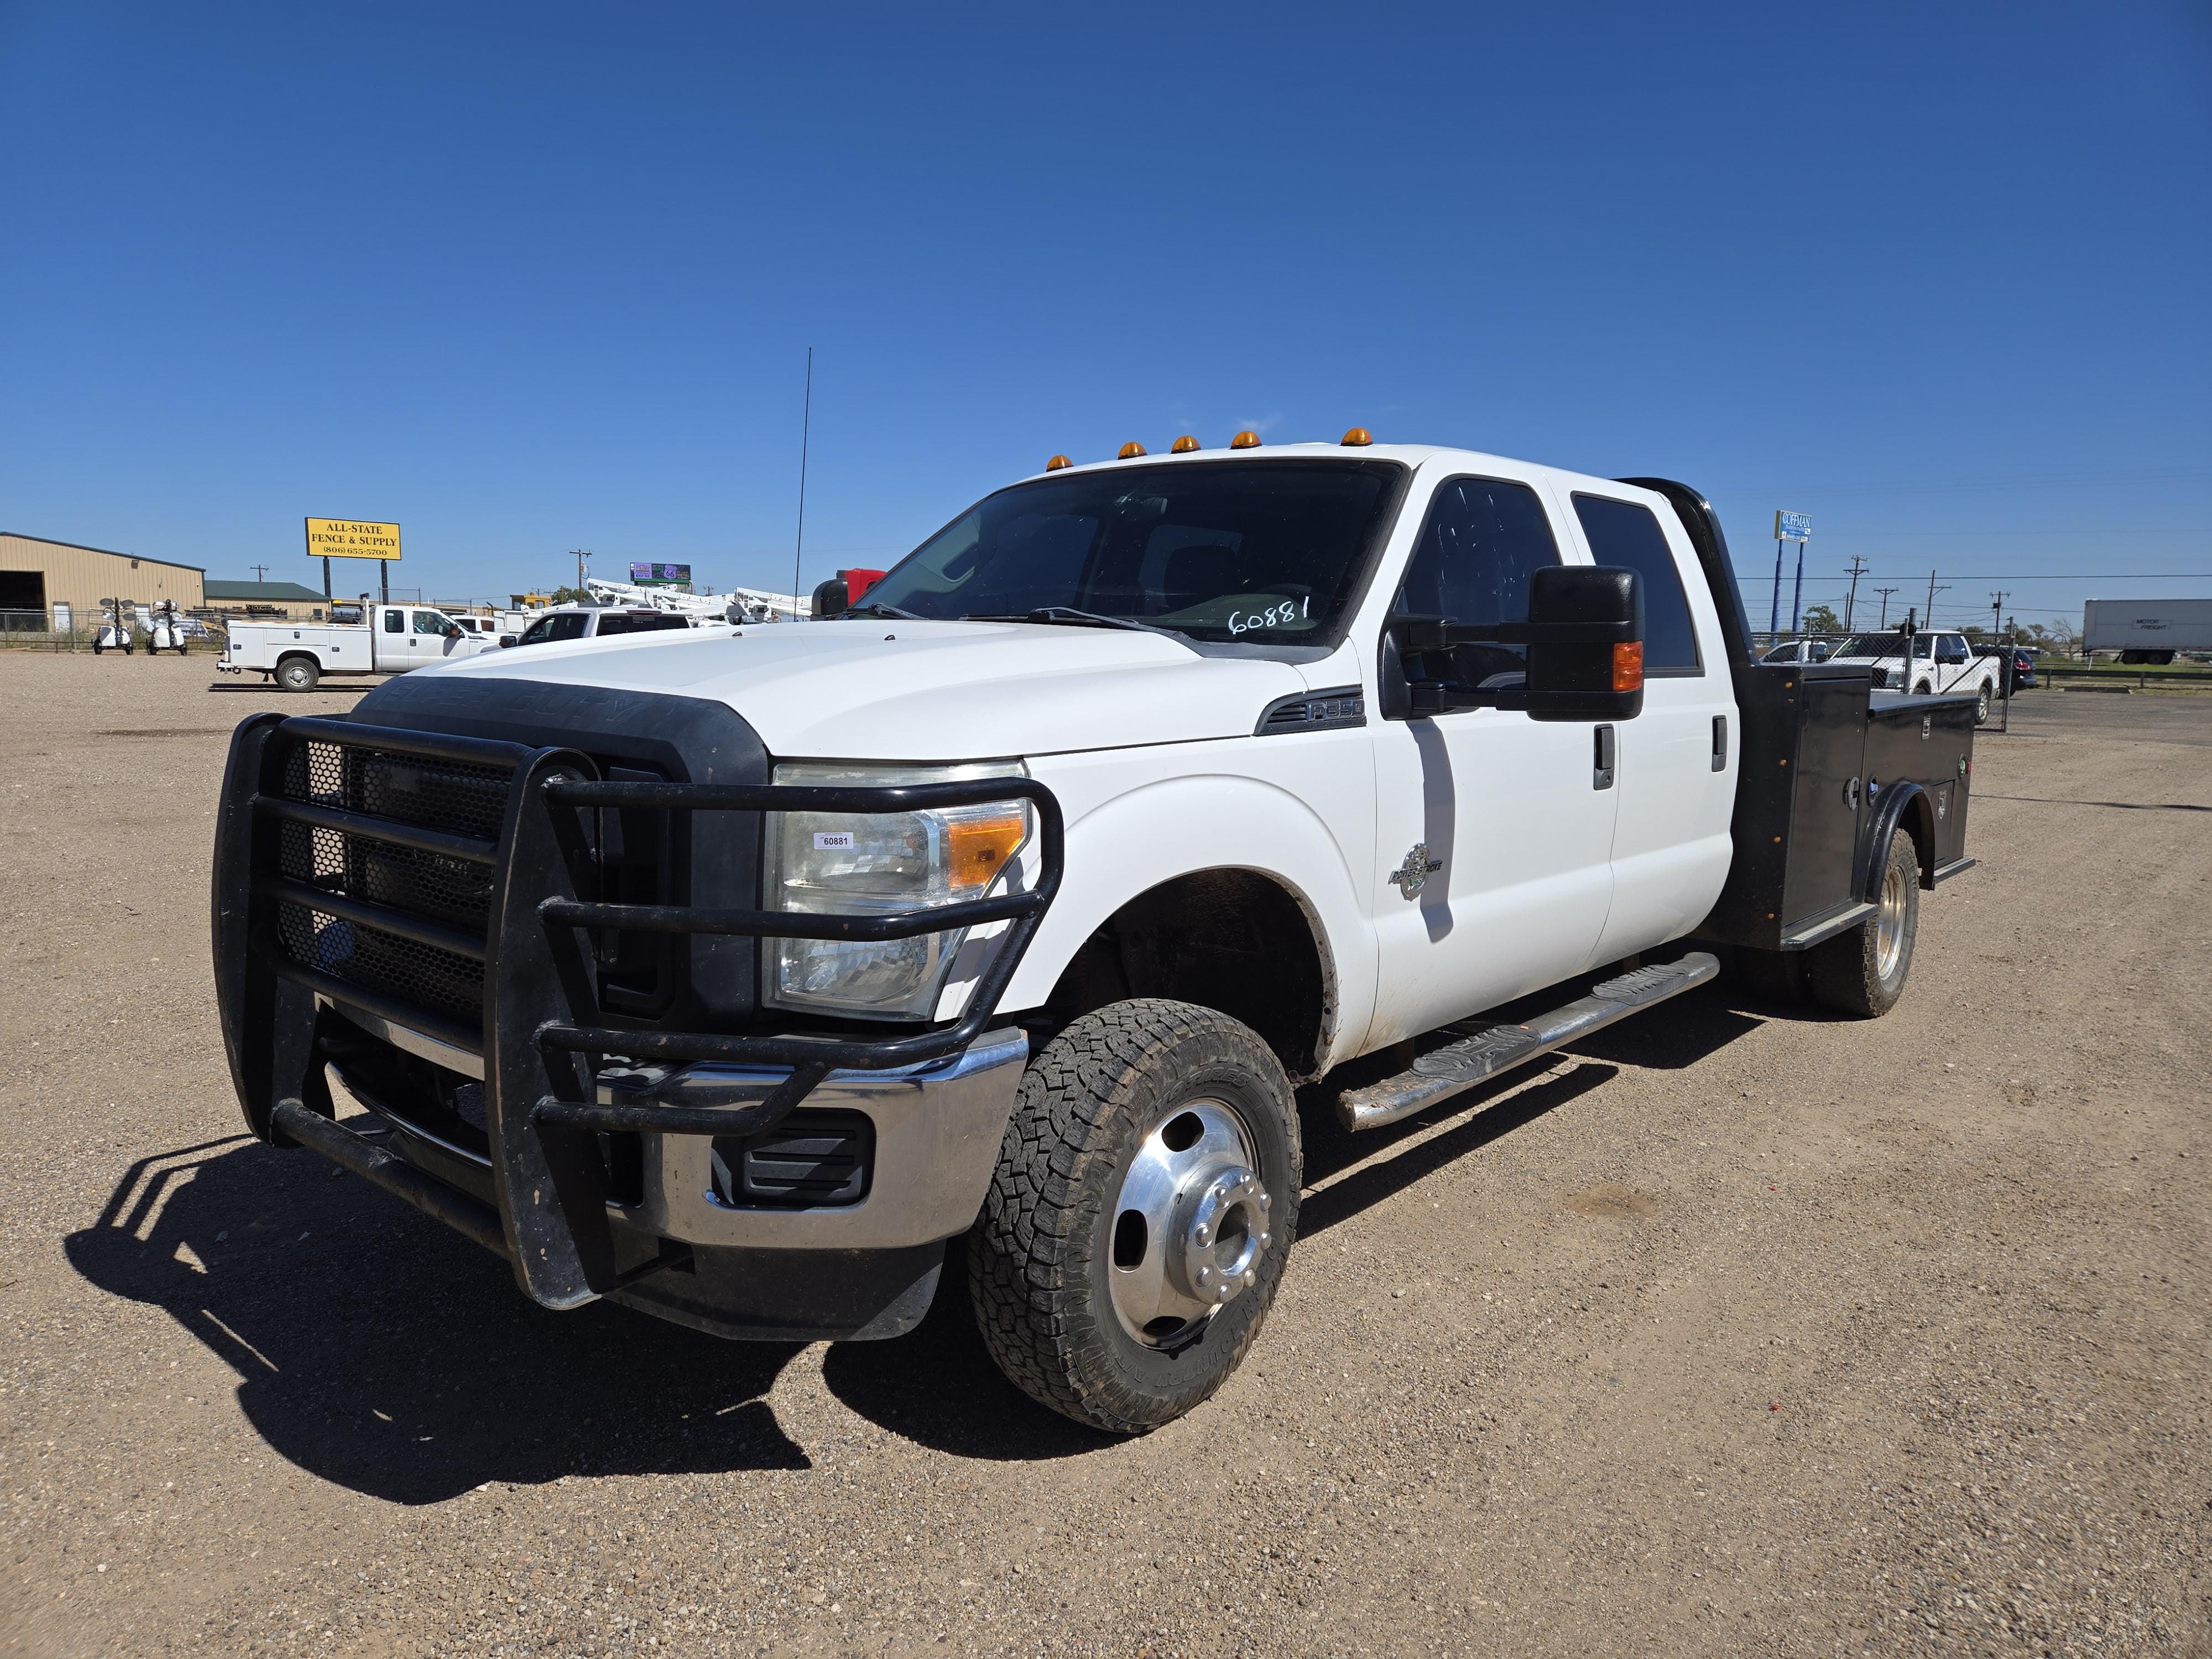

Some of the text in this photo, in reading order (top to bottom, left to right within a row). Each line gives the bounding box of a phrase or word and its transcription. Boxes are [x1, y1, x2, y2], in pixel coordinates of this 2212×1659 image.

[1782, 512, 1810, 528] COFFMAN
[326, 523, 383, 534] ALL-STATE
[312, 534, 397, 546] FENCE & SUPPLY
[324, 546, 387, 556] (806) 655-5700
[1228, 596, 1310, 635] 60881
[384, 682, 644, 722] SUPER DUTY
[1186, 1066, 1252, 1091] TIRES
